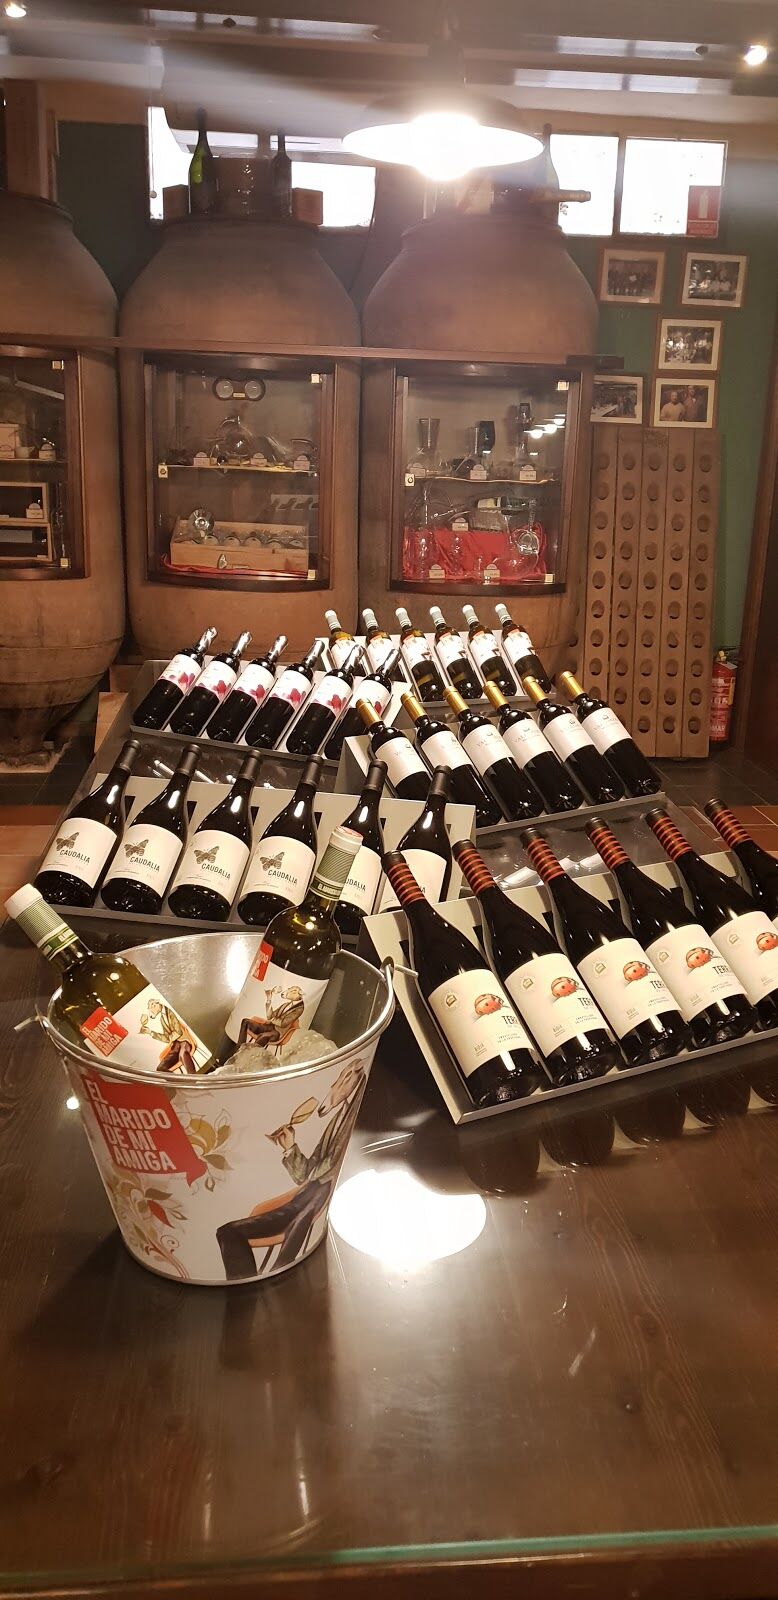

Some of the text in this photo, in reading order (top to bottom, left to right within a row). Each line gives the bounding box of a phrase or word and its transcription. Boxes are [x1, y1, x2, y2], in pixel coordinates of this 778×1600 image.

[60, 849, 91, 864] CAUDALIA
[129, 856, 161, 873] CAUDALIA
[201, 862, 232, 880] CAUDALIA
[267, 869, 299, 885] CAUDALIA
[345, 878, 366, 892] UDALIA
[86, 1080, 109, 1105] EL
[94, 1101, 172, 1130] MARIDO
[103, 1124, 157, 1151] DE MI
[113, 1146, 177, 1172] AMIGA
